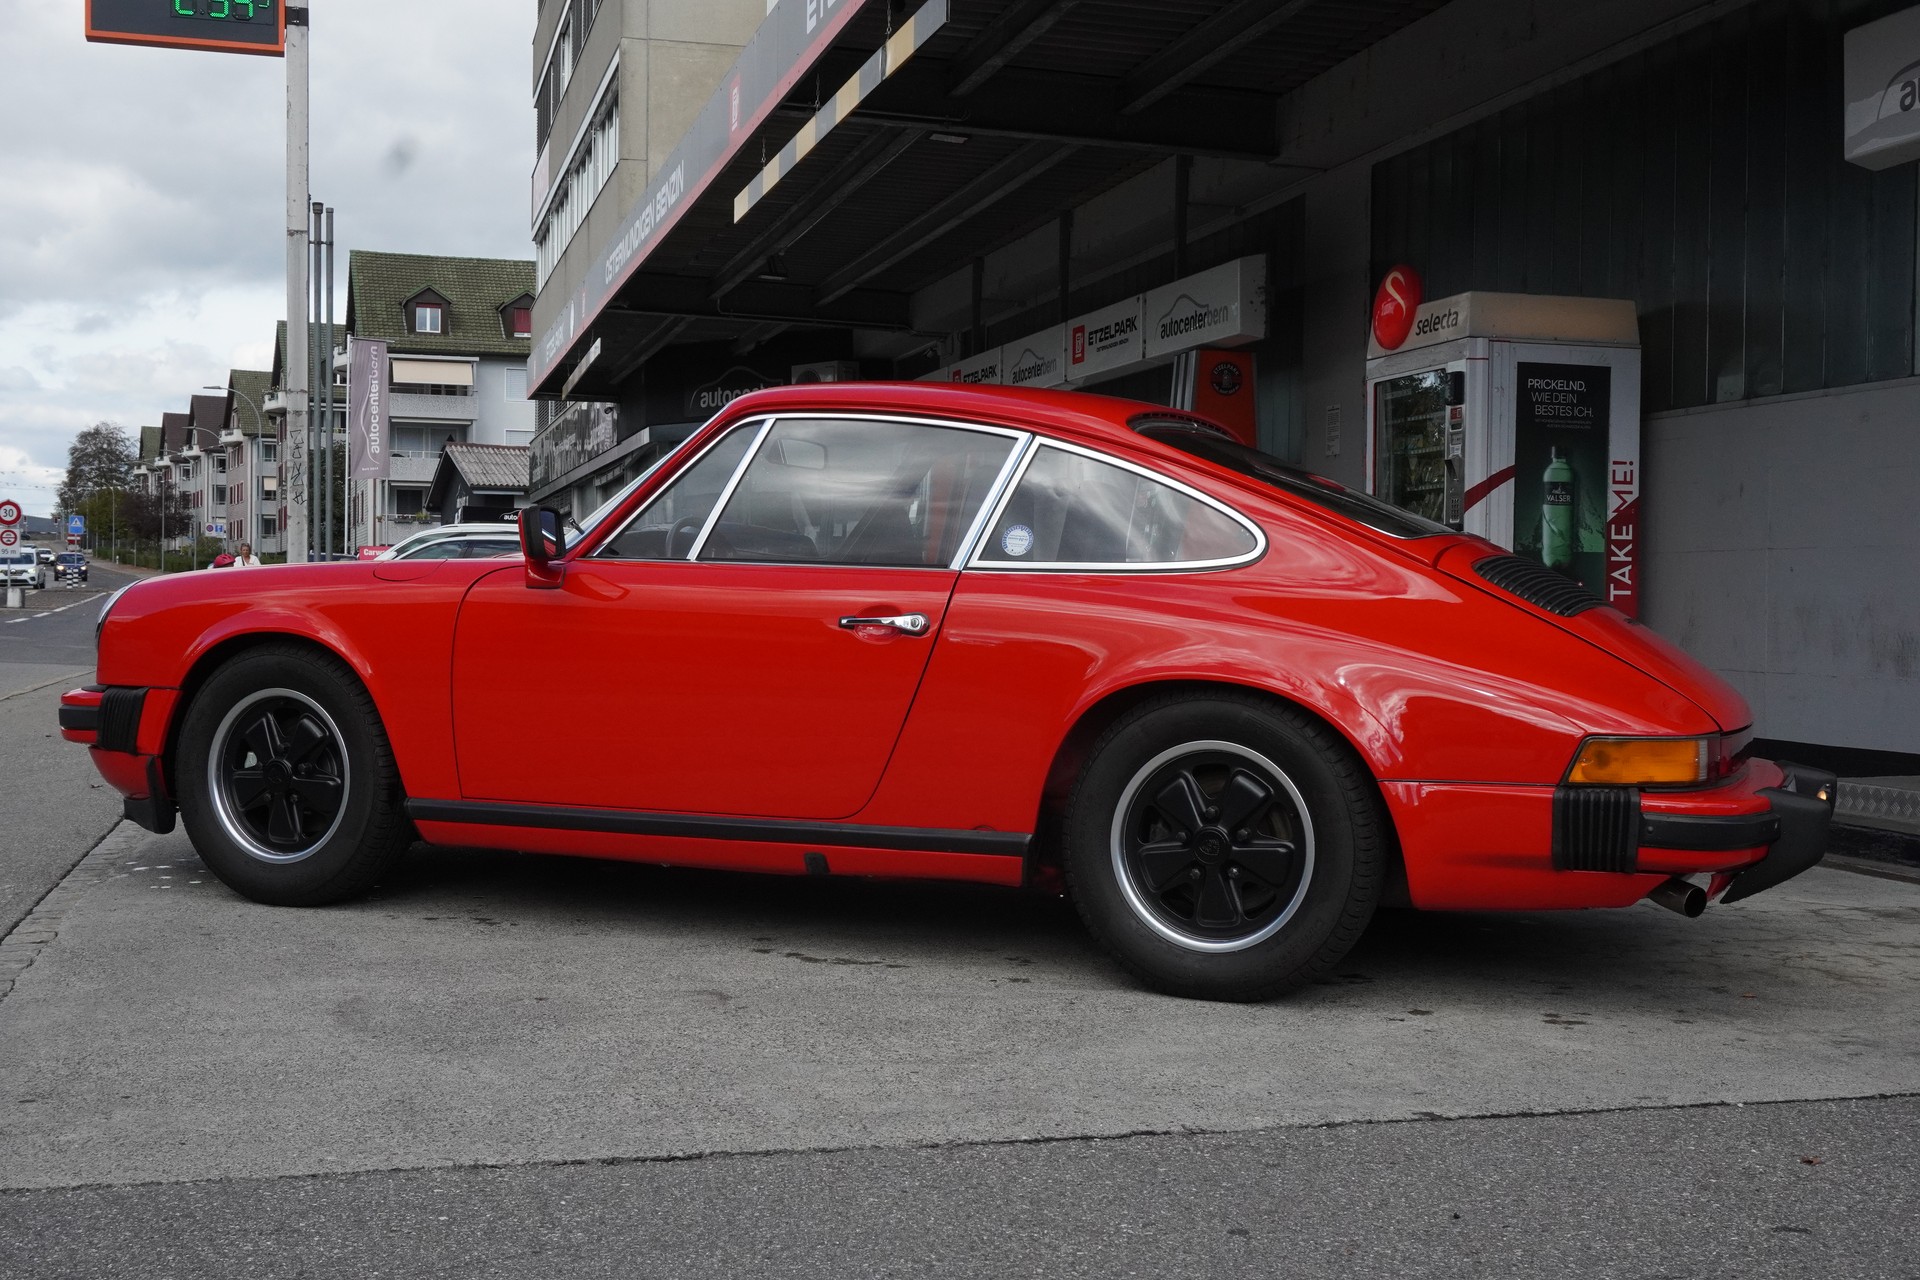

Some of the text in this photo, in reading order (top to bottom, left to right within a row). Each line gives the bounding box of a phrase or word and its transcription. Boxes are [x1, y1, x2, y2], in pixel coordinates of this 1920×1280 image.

[656, 159, 684, 224] BENZIN
[1088, 314, 1138, 346] ETZELPARK
[1415, 309, 1459, 337] selecta
[1527, 378, 1587, 392] PRICKELND,
[1531, 391, 1577, 404] WIE DEIN
[1535, 405, 1594, 418] BESTES ICH.
[1546, 494, 1571, 502] VALSER
[3, 509, 14, 518] 30
[1609, 460, 1634, 602] TAKE ME!
